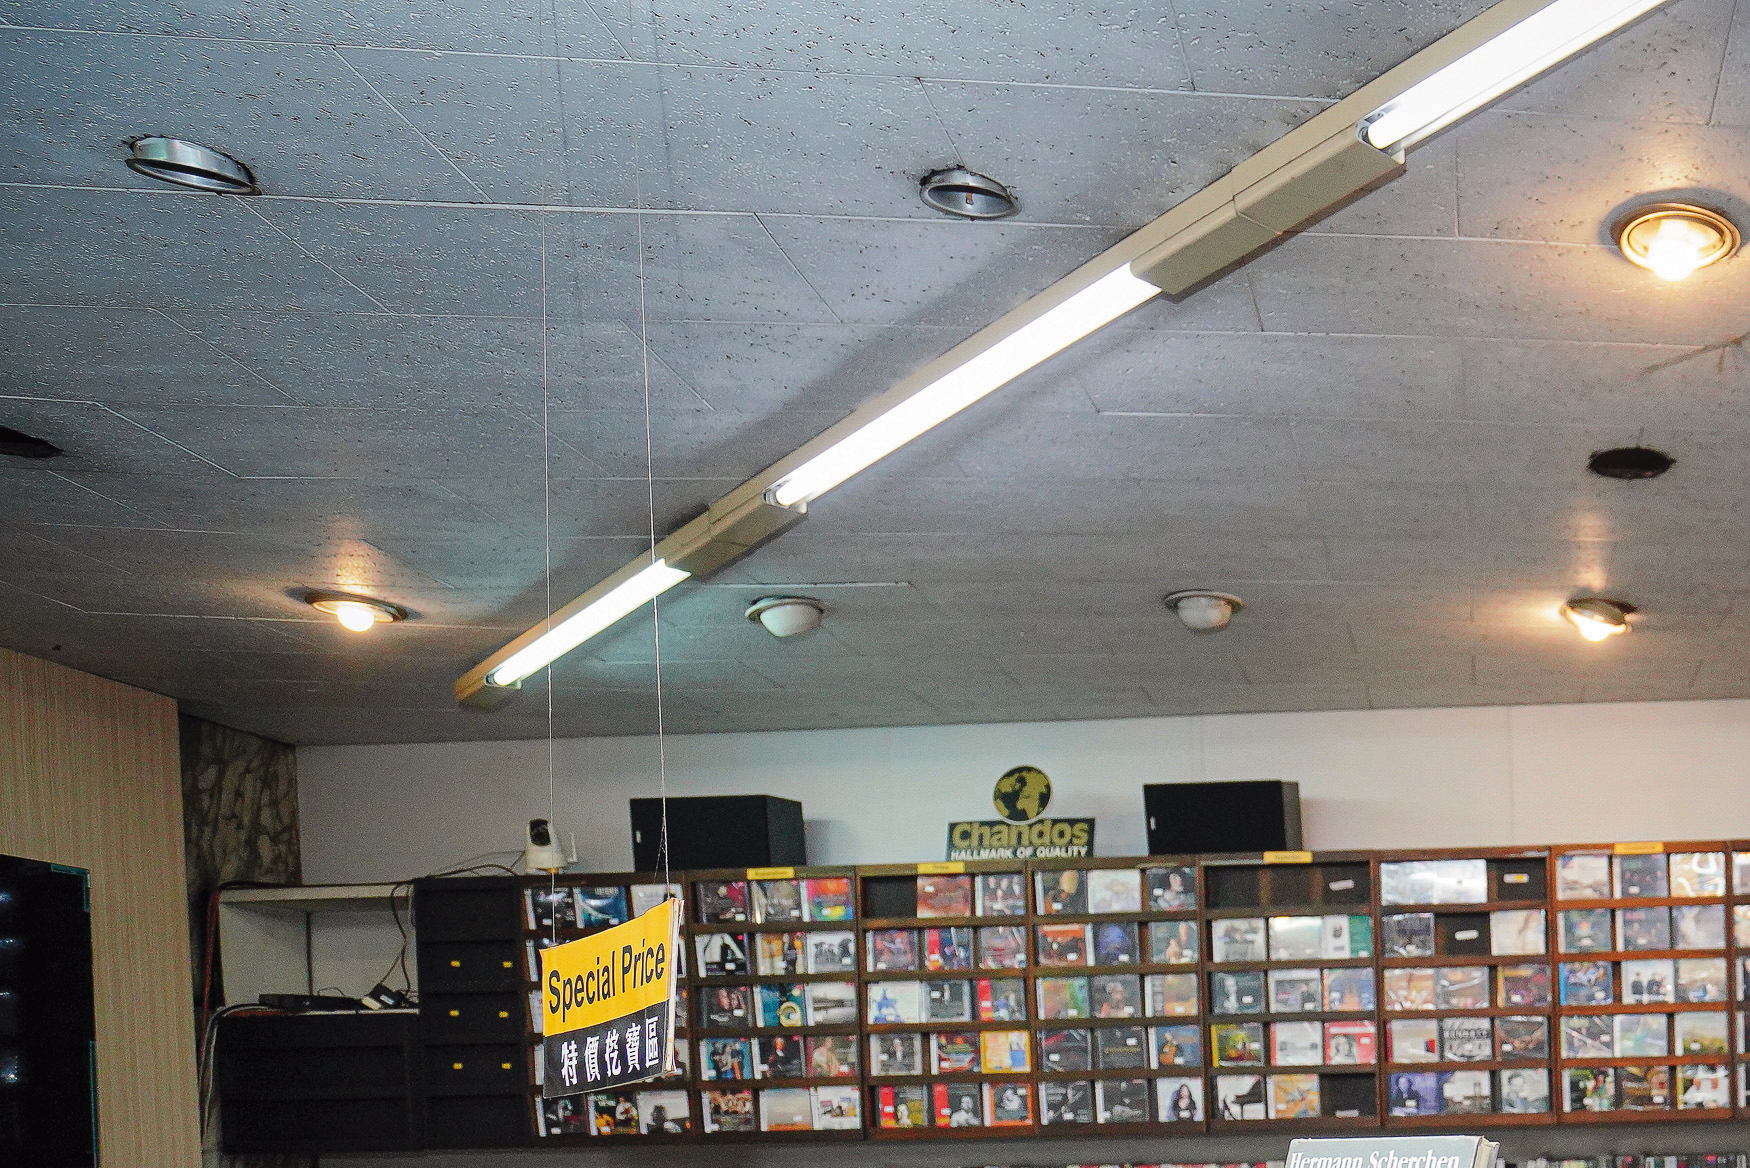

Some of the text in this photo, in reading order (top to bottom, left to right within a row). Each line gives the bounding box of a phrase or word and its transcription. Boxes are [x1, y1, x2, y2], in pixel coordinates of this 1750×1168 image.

[951, 845, 1088, 860] HALLMARK OF QUALITY
[549, 938, 665, 1023] Special Price
[561, 1016, 660, 1086] 特價挖寶區
